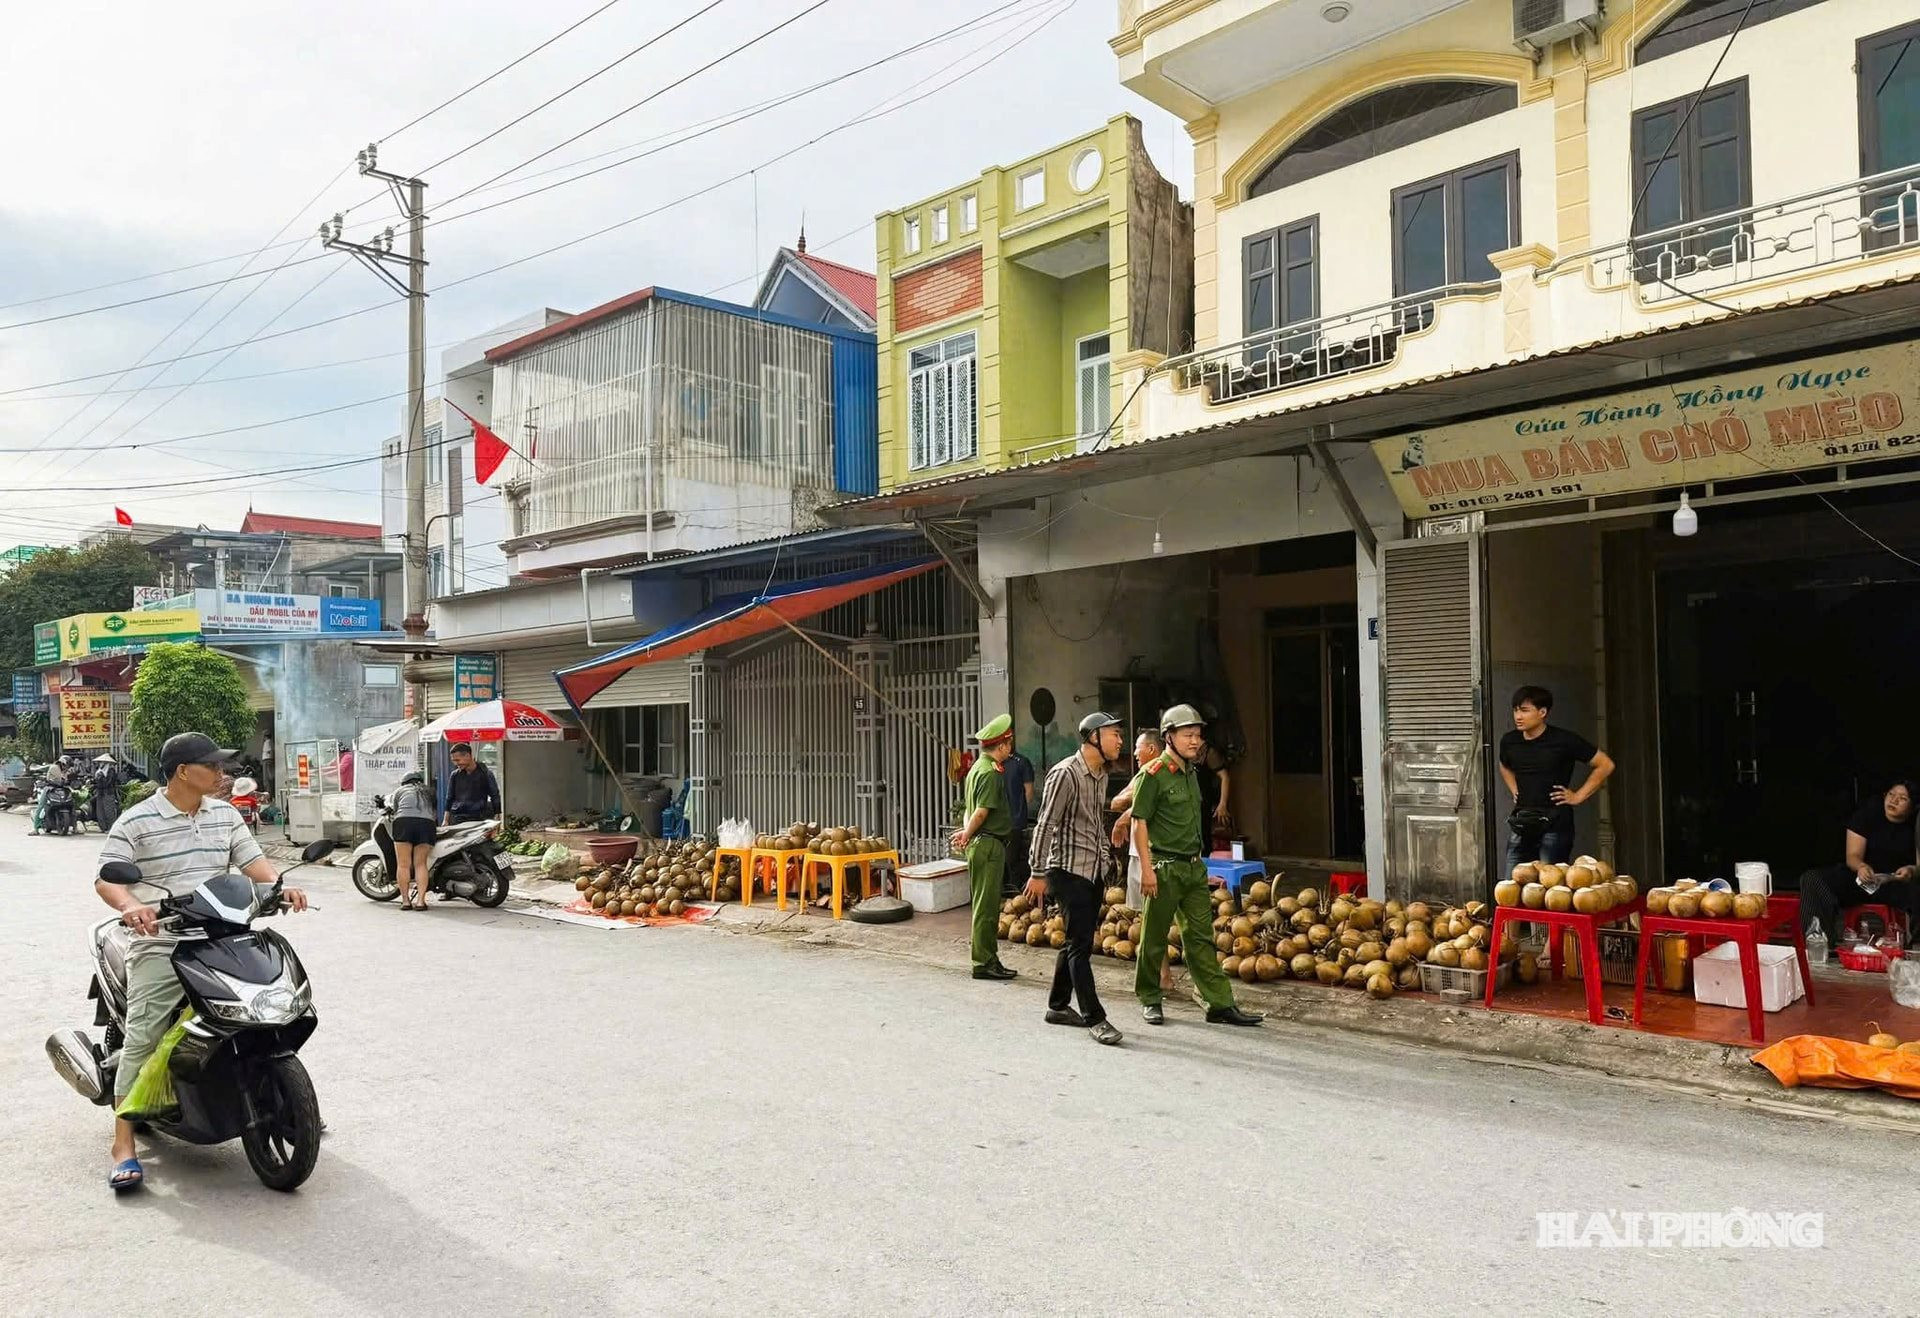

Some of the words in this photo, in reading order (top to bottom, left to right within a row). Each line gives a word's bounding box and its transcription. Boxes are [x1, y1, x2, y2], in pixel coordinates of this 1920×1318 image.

[1576, 402, 1663, 426] Hàng
[1674, 384, 1766, 410] Hồng
[1777, 365, 1871, 391] Ngọc
[1407, 451, 1519, 498] MUA
[1521, 434, 1630, 481] BÁN
[1639, 407, 1751, 464] CHÓ
[1764, 389, 1904, 447] MÈO
[1503, 488, 1544, 501] 2481
[1551, 483, 1583, 495] 591
[267, 608, 289, 617] MOBIL
[106, 619, 124, 628] SP
[330, 613, 368, 627] Mobil
[64, 700, 86, 710] XE
[69, 711, 93, 720] XE
[514, 717, 545, 727] OMO
[70, 724, 96, 733] XE
